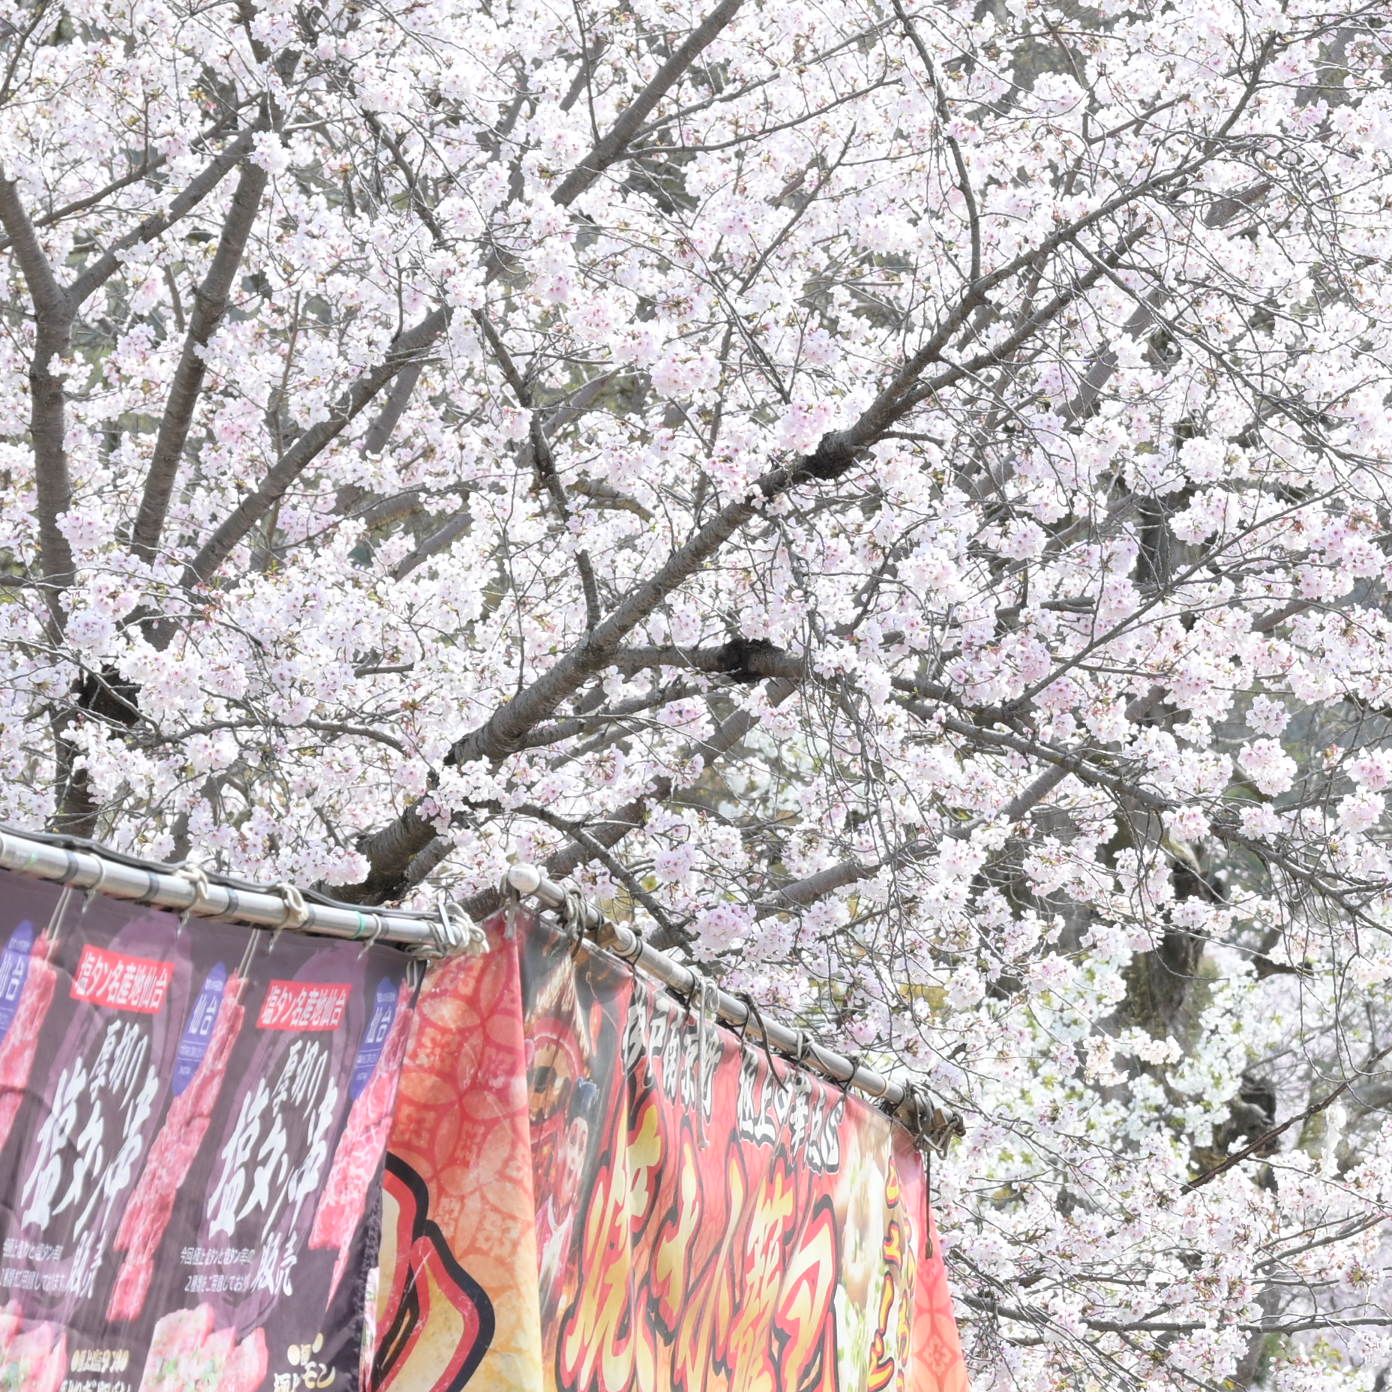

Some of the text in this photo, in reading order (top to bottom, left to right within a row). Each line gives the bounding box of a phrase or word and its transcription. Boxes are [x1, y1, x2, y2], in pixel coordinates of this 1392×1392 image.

[262, 984, 348, 1027] 塩タン名産地仙台
